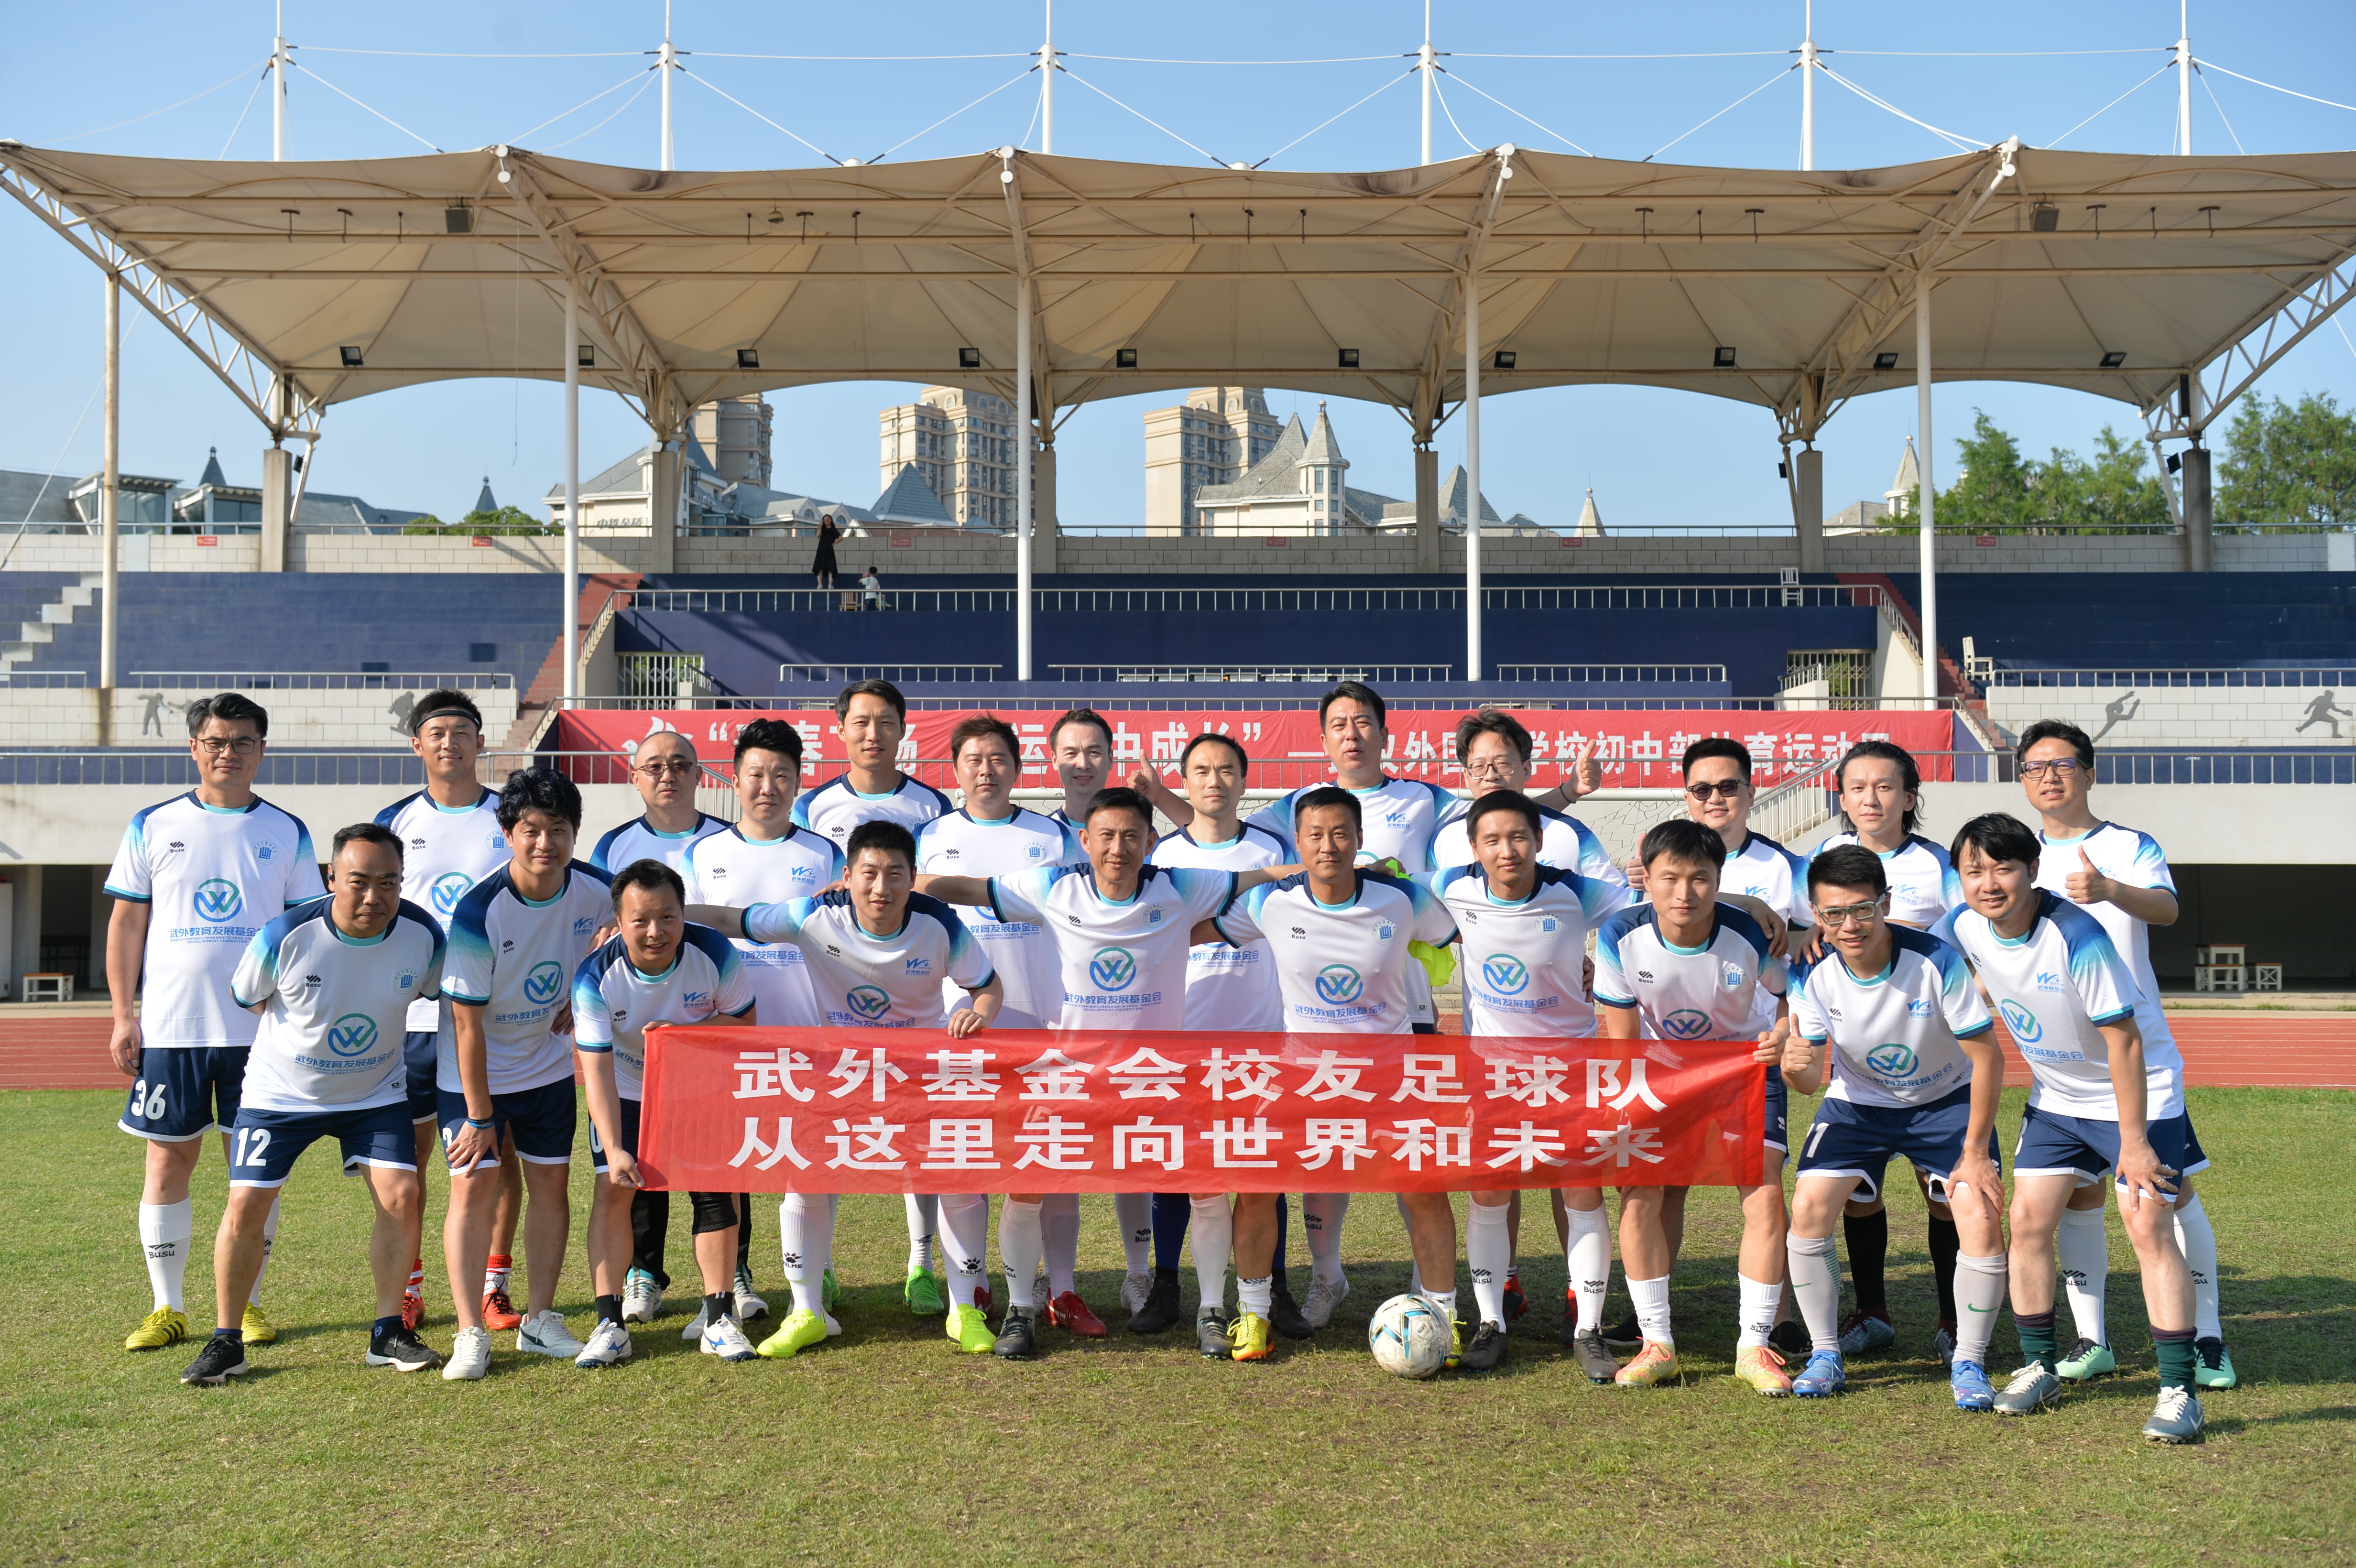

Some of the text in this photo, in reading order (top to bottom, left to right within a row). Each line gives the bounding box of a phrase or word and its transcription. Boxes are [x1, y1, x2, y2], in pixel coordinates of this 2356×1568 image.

[170, 926, 262, 938] 武外教育发展基金
[1064, 991, 1162, 1005] 武外教育发展基金会
[1295, 1002, 1387, 1018] 武外教育发展基金会
[294, 1048, 395, 1069] 武外教育发展基金会
[732, 1047, 1667, 1111] 武外基金会校友足球队
[131, 1079, 166, 1120] 36
[235, 1127, 271, 1166] 12
[728, 1116, 1666, 1172] 从这里走向世界和未来
[1806, 1122, 1829, 1158] 1
